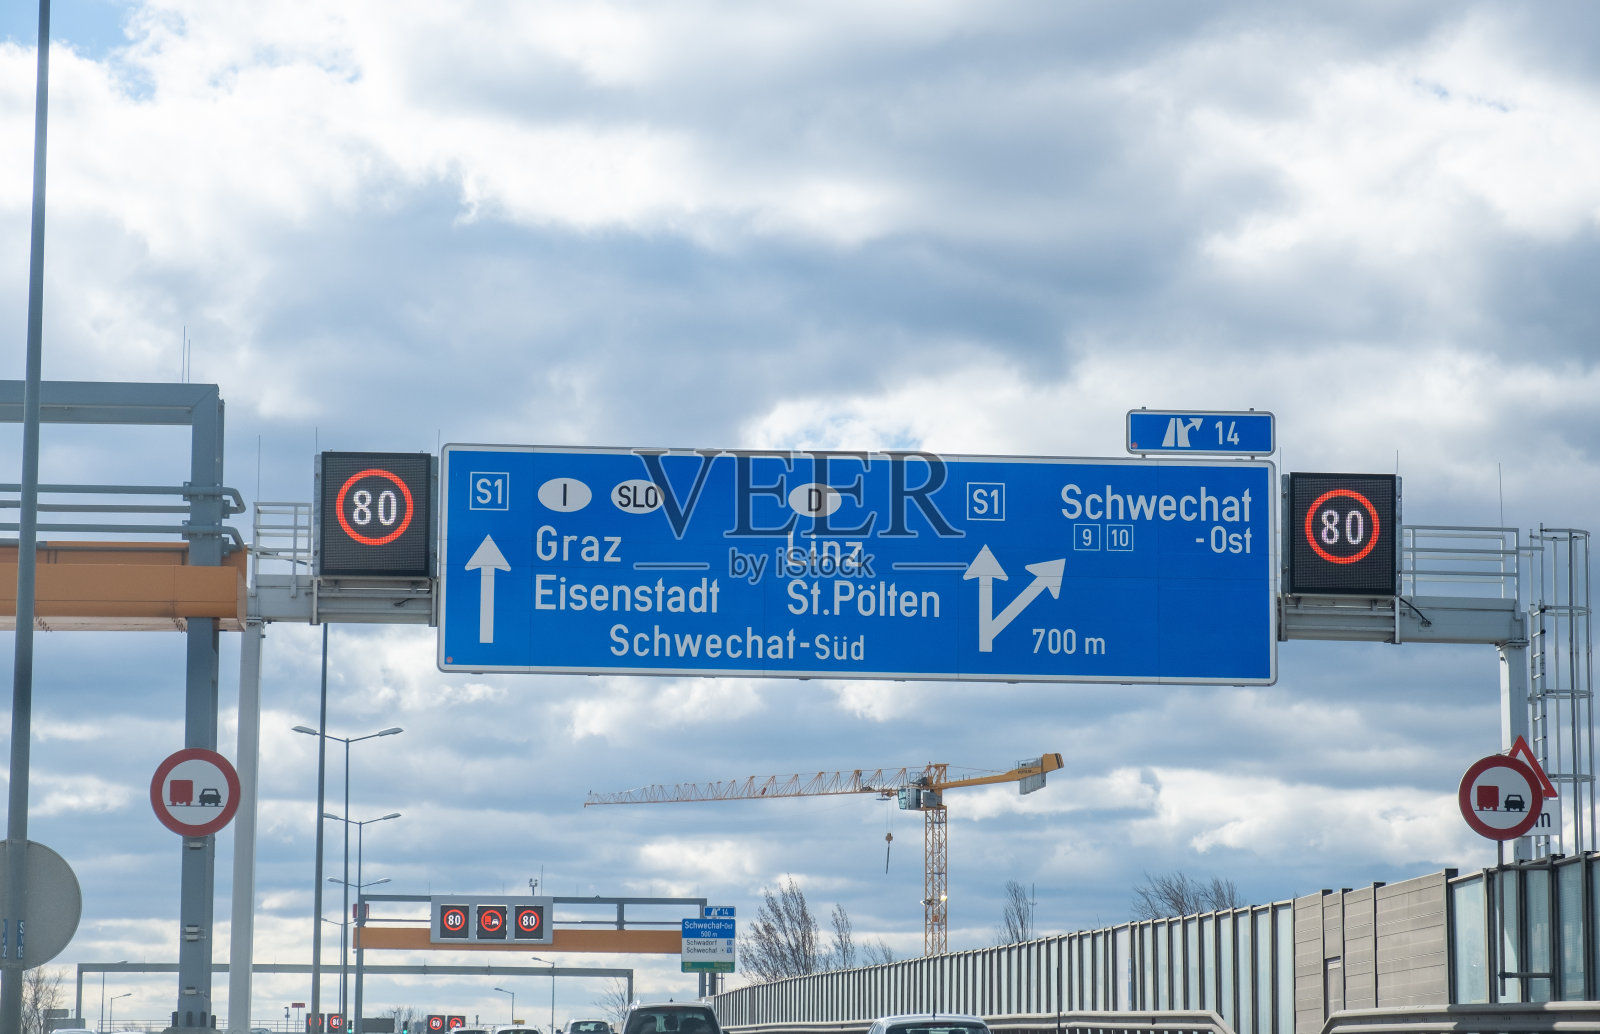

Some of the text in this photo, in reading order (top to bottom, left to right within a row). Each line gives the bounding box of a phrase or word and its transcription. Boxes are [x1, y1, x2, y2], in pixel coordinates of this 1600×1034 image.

[1215, 421, 1240, 445] 14
[476, 478, 505, 505] S1
[562, 483, 568, 507] I
[807, 488, 822, 512] D
[973, 489, 999, 515] S1
[1061, 484, 1252, 522] Schwechat
[353, 490, 397, 526] 80
[1082, 529, 1092, 546] 9
[1111, 529, 1129, 547] 10
[1321, 509, 1364, 545] 80
[536, 525, 622, 563] Graz
[787, 531, 863, 567] Linz
[534, 574, 720, 614] Eisenstadt
[609, 623, 865, 662] Schwechat-Süd
[1032, 628, 1106, 655] 700 m
[448, 915, 461, 926] 80
[522, 915, 536, 926] 80
